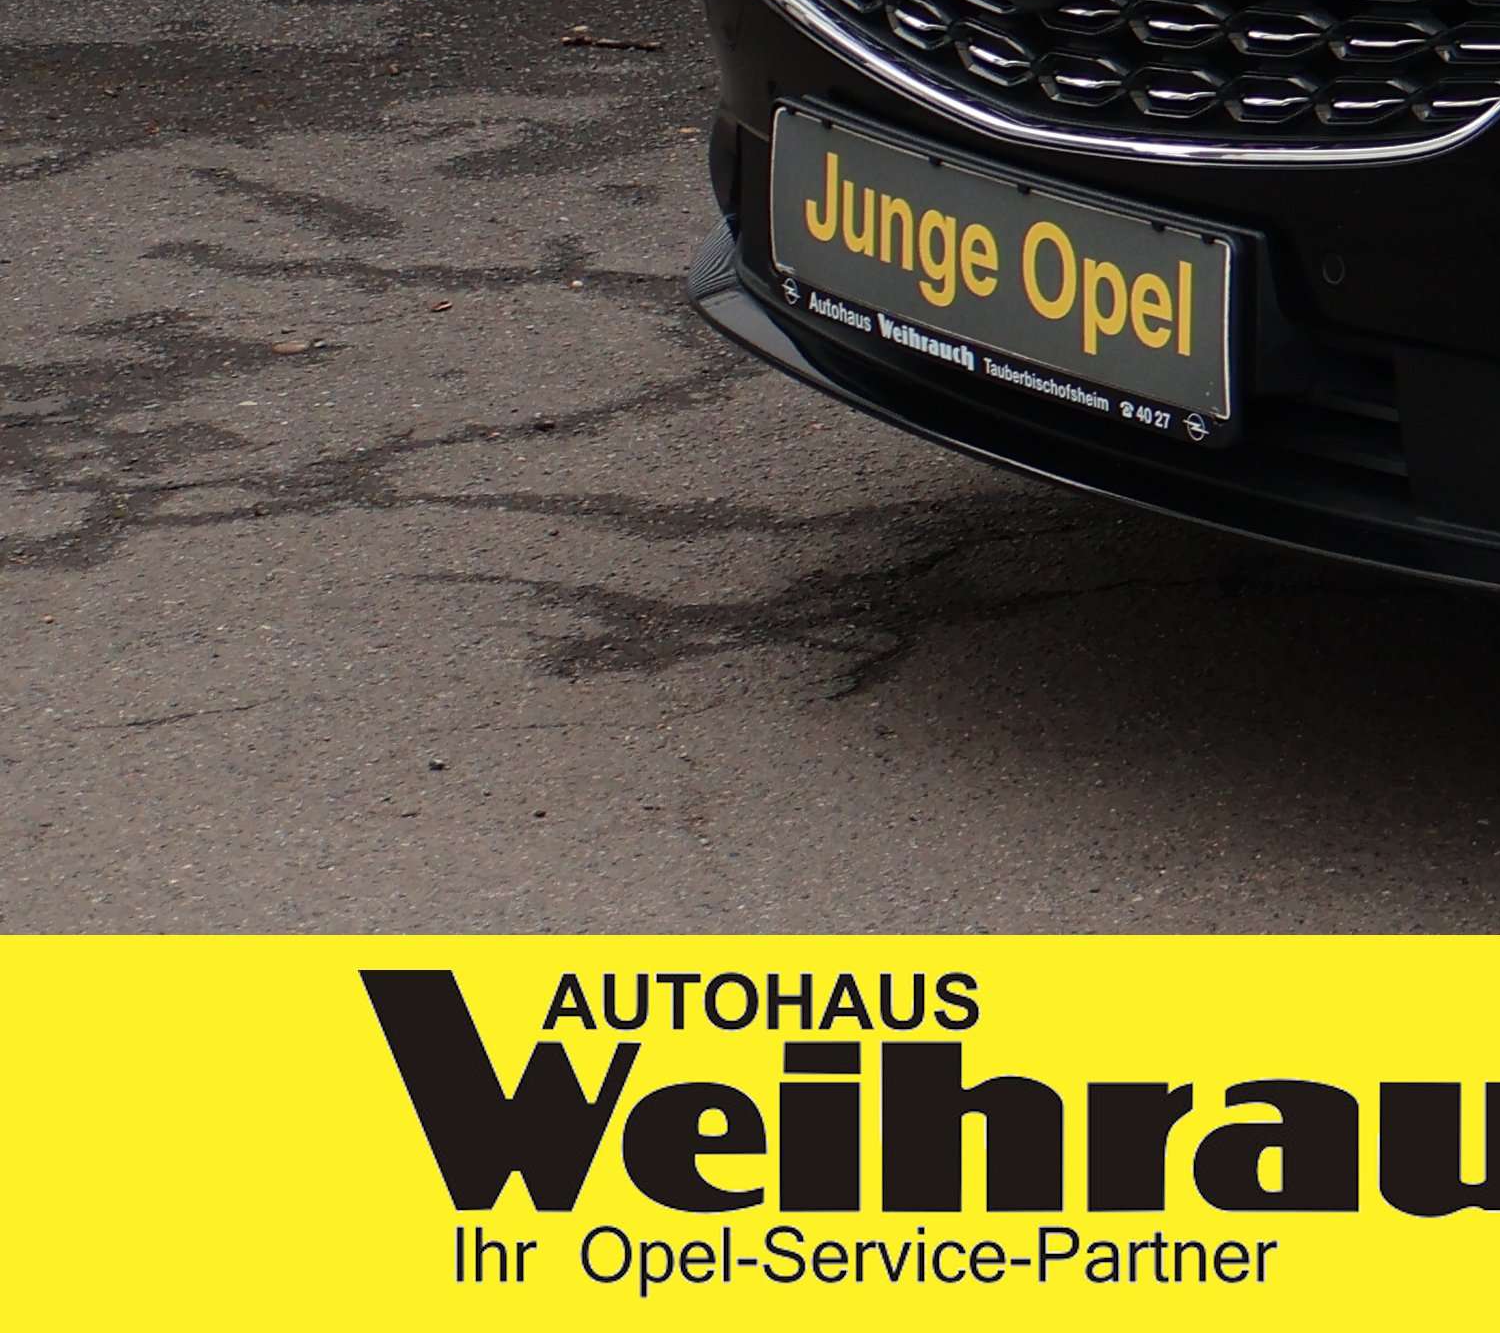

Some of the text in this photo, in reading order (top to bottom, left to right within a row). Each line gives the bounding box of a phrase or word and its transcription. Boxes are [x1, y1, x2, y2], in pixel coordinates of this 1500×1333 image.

[804, 151, 1193, 357] Junge Opel
[808, 290, 1172, 430] Autohaus Weihrauch Tauberbischofsheim 40 27
